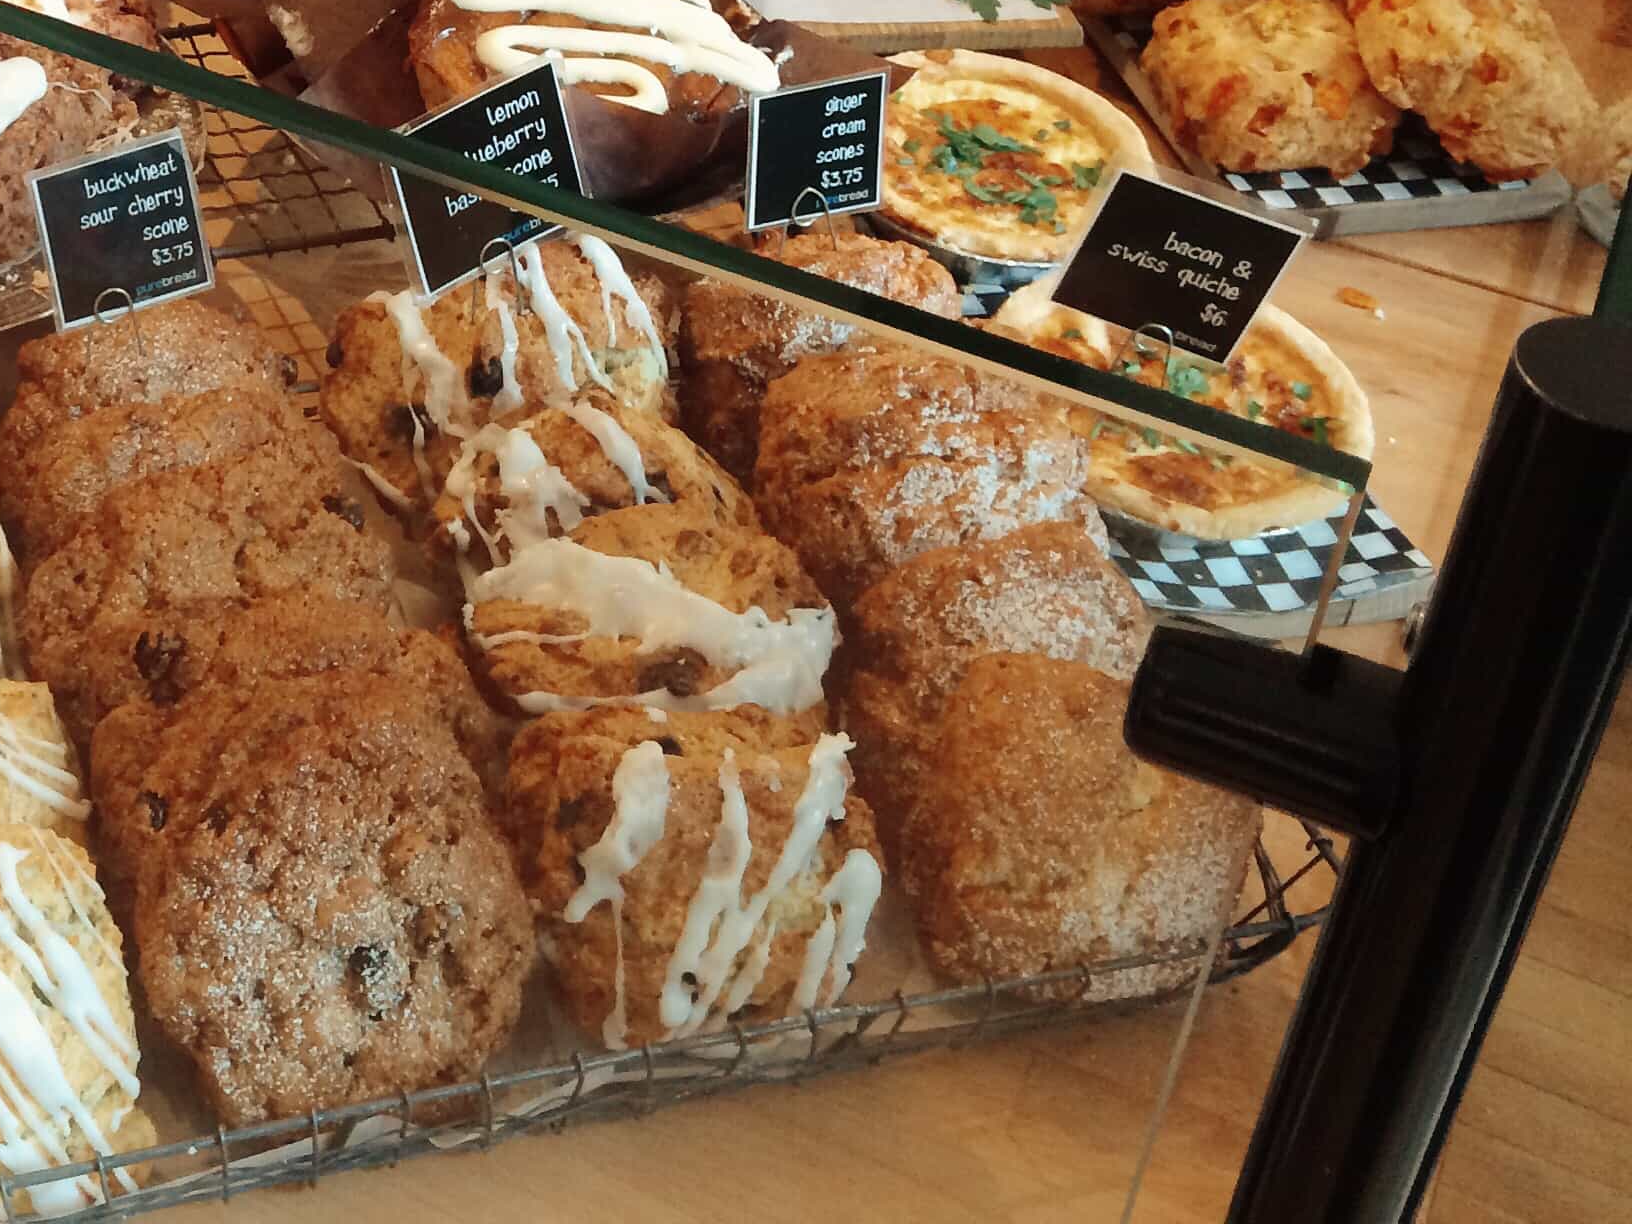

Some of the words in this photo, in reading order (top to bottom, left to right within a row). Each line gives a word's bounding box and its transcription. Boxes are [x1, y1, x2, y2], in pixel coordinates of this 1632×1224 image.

[485, 89, 541, 126] lemon
[824, 92, 868, 117] ginger
[464, 116, 547, 163] ueberry
[822, 118, 867, 139] cream
[504, 148, 553, 176] cone
[815, 143, 865, 164] scones
[83, 153, 178, 200] buckwheat
[820, 166, 864, 189] $3.75
[80, 205, 119, 230] sour
[127, 185, 184, 217] cherry
[444, 193, 482, 217] bas
[143, 215, 190, 241] scone
[151, 240, 194, 266] $3.75
[1163, 231, 1224, 270] bacon
[1232, 260, 1254, 281] &
[1107, 242, 1170, 274] swiss
[1177, 266, 1241, 302] quiche
[1200, 302, 1228, 327] $6
